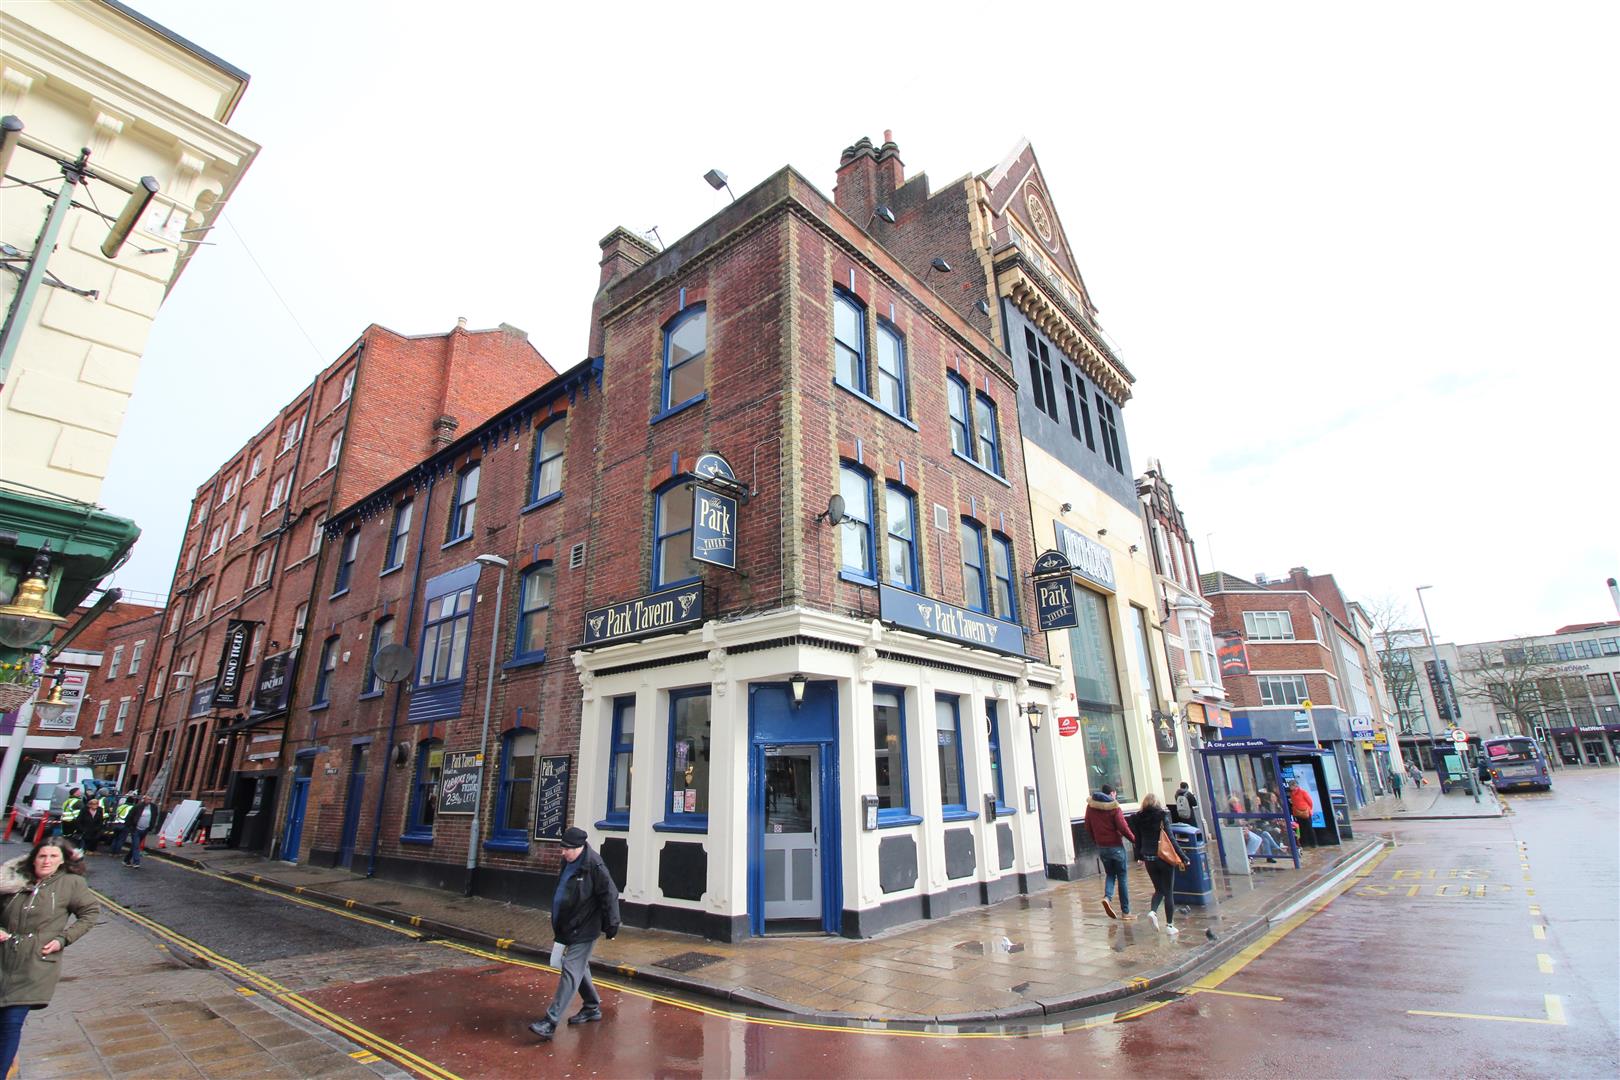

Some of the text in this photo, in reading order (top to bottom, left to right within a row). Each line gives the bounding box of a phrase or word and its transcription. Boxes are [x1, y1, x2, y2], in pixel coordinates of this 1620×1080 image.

[700, 498, 730, 535] Park
[704, 538, 726, 549] TAVERN
[1040, 585, 1069, 608] Park
[606, 599, 674, 639] Park Tavern
[1047, 609, 1067, 621] TAVERN
[934, 603, 987, 643] Park Tavern
[224, 659, 238, 686] BLIND
[231, 631, 244, 658] TIGER
[1558, 664, 1590, 673] NatWest
[452, 754, 461, 768] Park
[542, 760, 553, 776] Park
[1392, 868, 1491, 880] BUS
[1354, 884, 1512, 897] STOP
